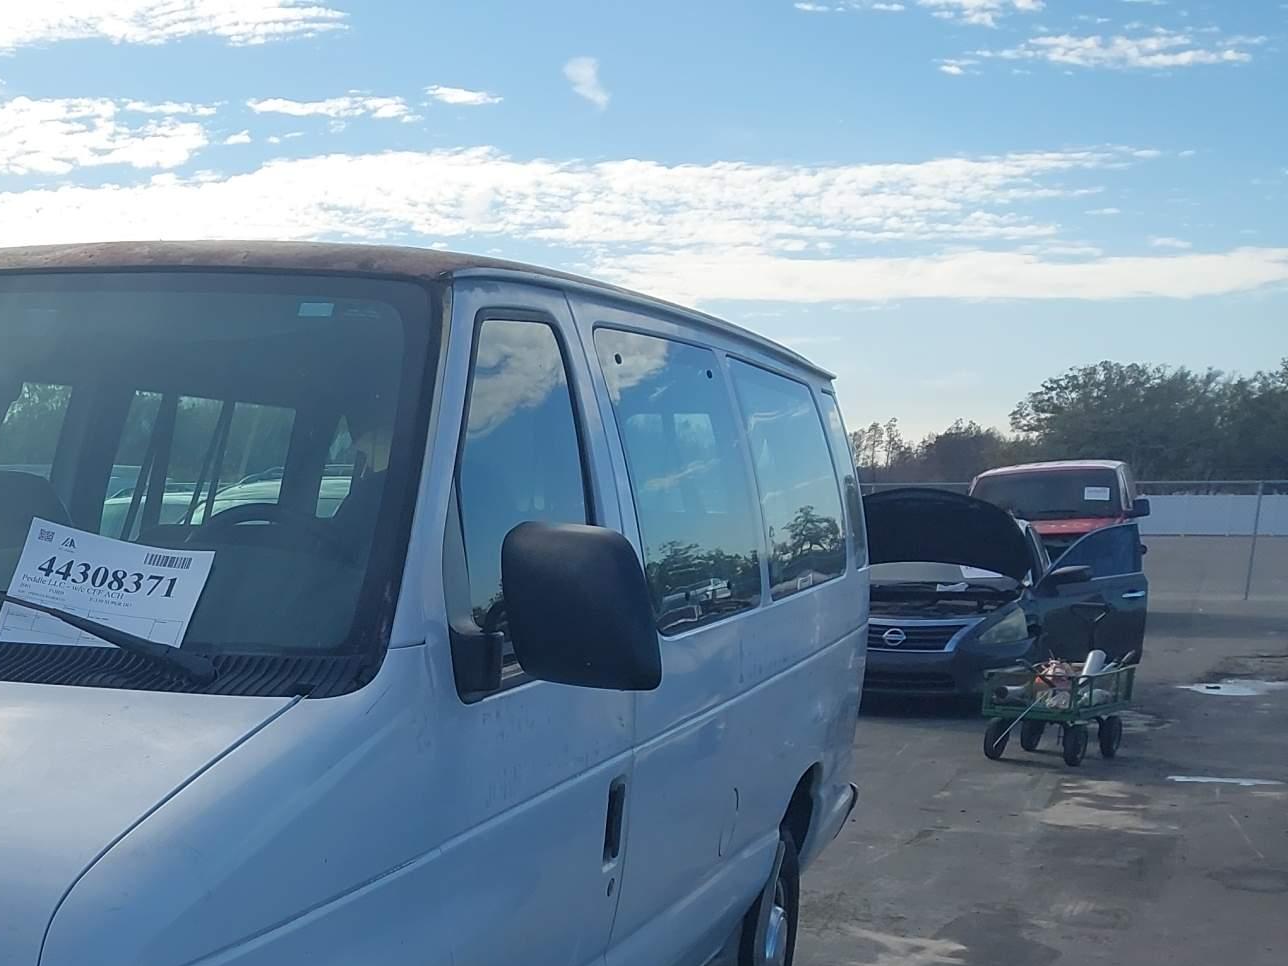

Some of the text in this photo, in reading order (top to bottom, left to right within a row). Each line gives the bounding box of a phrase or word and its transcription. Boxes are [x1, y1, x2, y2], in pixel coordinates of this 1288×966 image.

[22, 573, 47, 586] Peddle
[48, 579, 66, 590] LLC
[104, 591, 125, 601] ACH
[38, 556, 179, 599] 44308371
